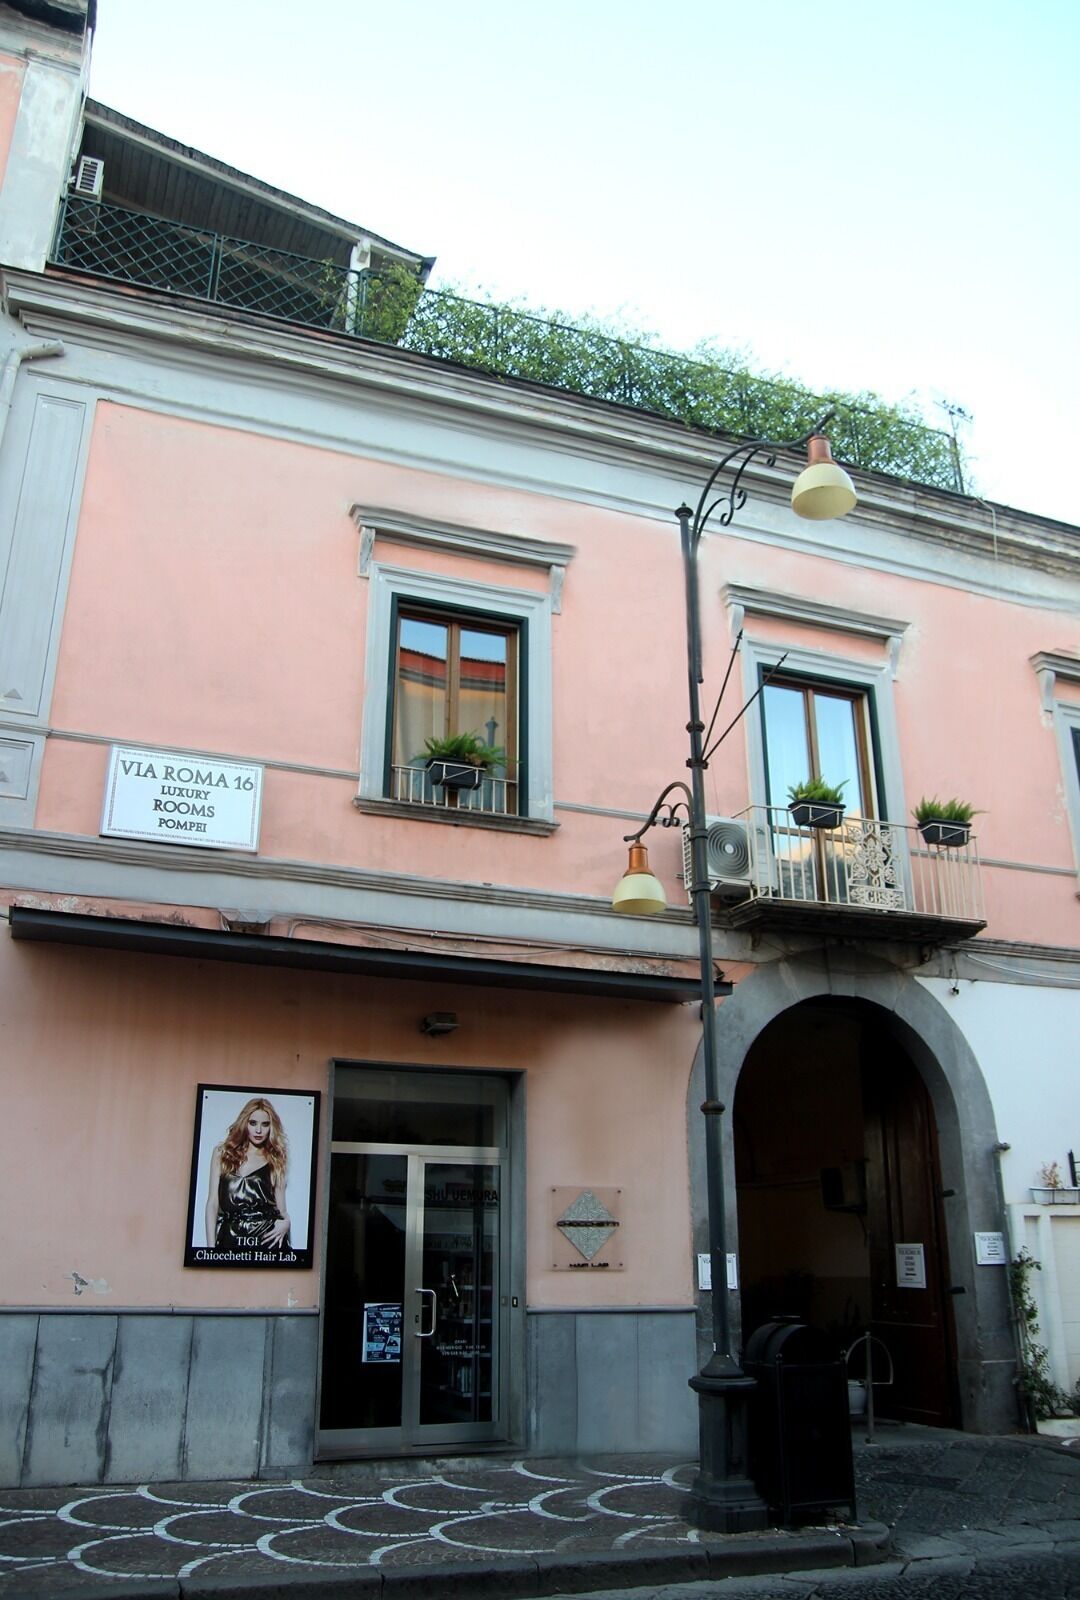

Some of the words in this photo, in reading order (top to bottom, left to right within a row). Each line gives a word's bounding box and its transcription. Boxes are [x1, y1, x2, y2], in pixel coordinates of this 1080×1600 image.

[120, 759, 158, 779] VIA
[162, 765, 230, 789] ROMA
[233, 775, 254, 791] 16
[160, 785, 211, 801] LUXURY
[152, 798, 215, 818] ROOMS
[157, 817, 208, 833] POMPEI
[425, 1189, 448, 1201] SHU
[452, 1190, 498, 1201] UEMURA
[236, 1236, 259, 1246] TIGI
[195, 1249, 252, 1261] Chiocchetti
[254, 1251, 277, 1262] Hair
[279, 1252, 297, 1262] Lab
